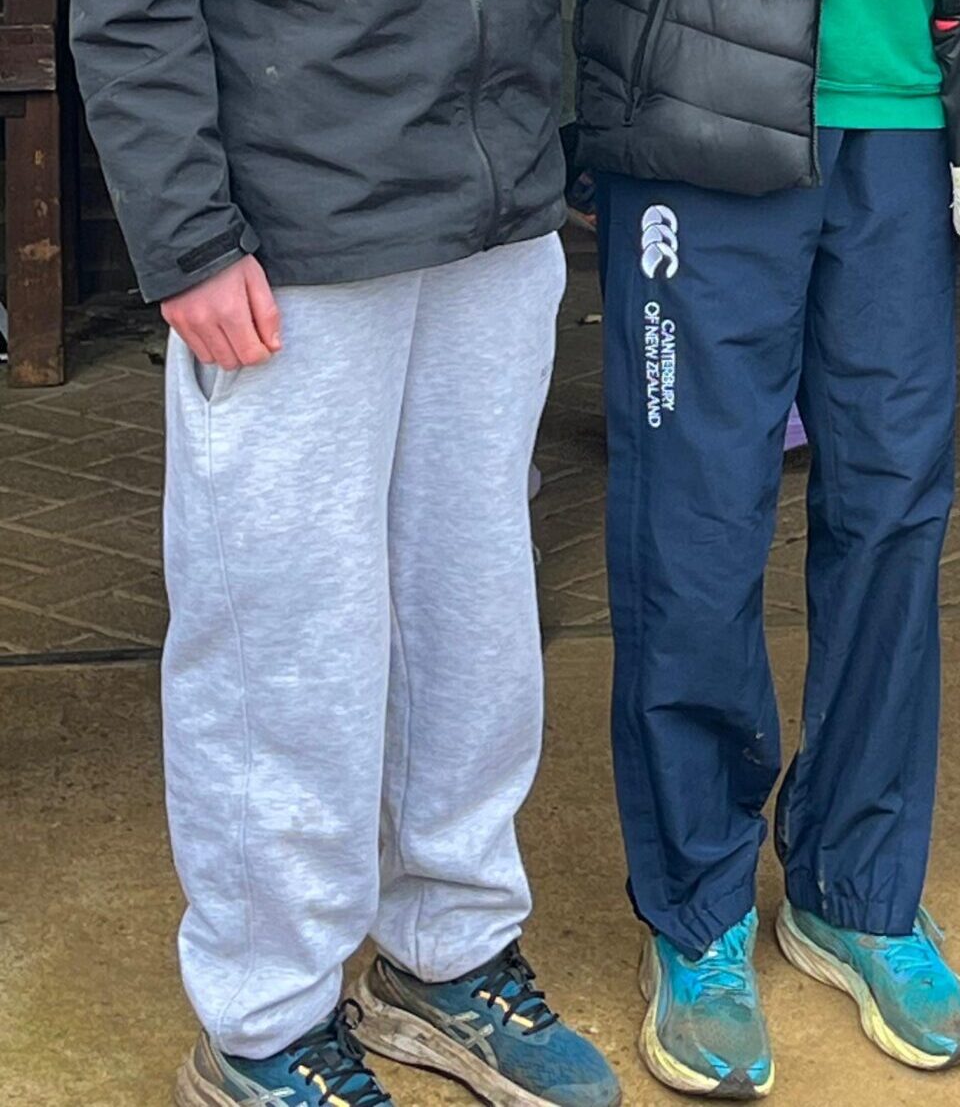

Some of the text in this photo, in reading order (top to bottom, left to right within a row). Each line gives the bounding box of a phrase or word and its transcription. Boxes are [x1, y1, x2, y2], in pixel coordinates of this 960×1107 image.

[644, 301, 661, 428] OF NEW ZEALAND
[661, 319, 676, 411] CANTERBURY
